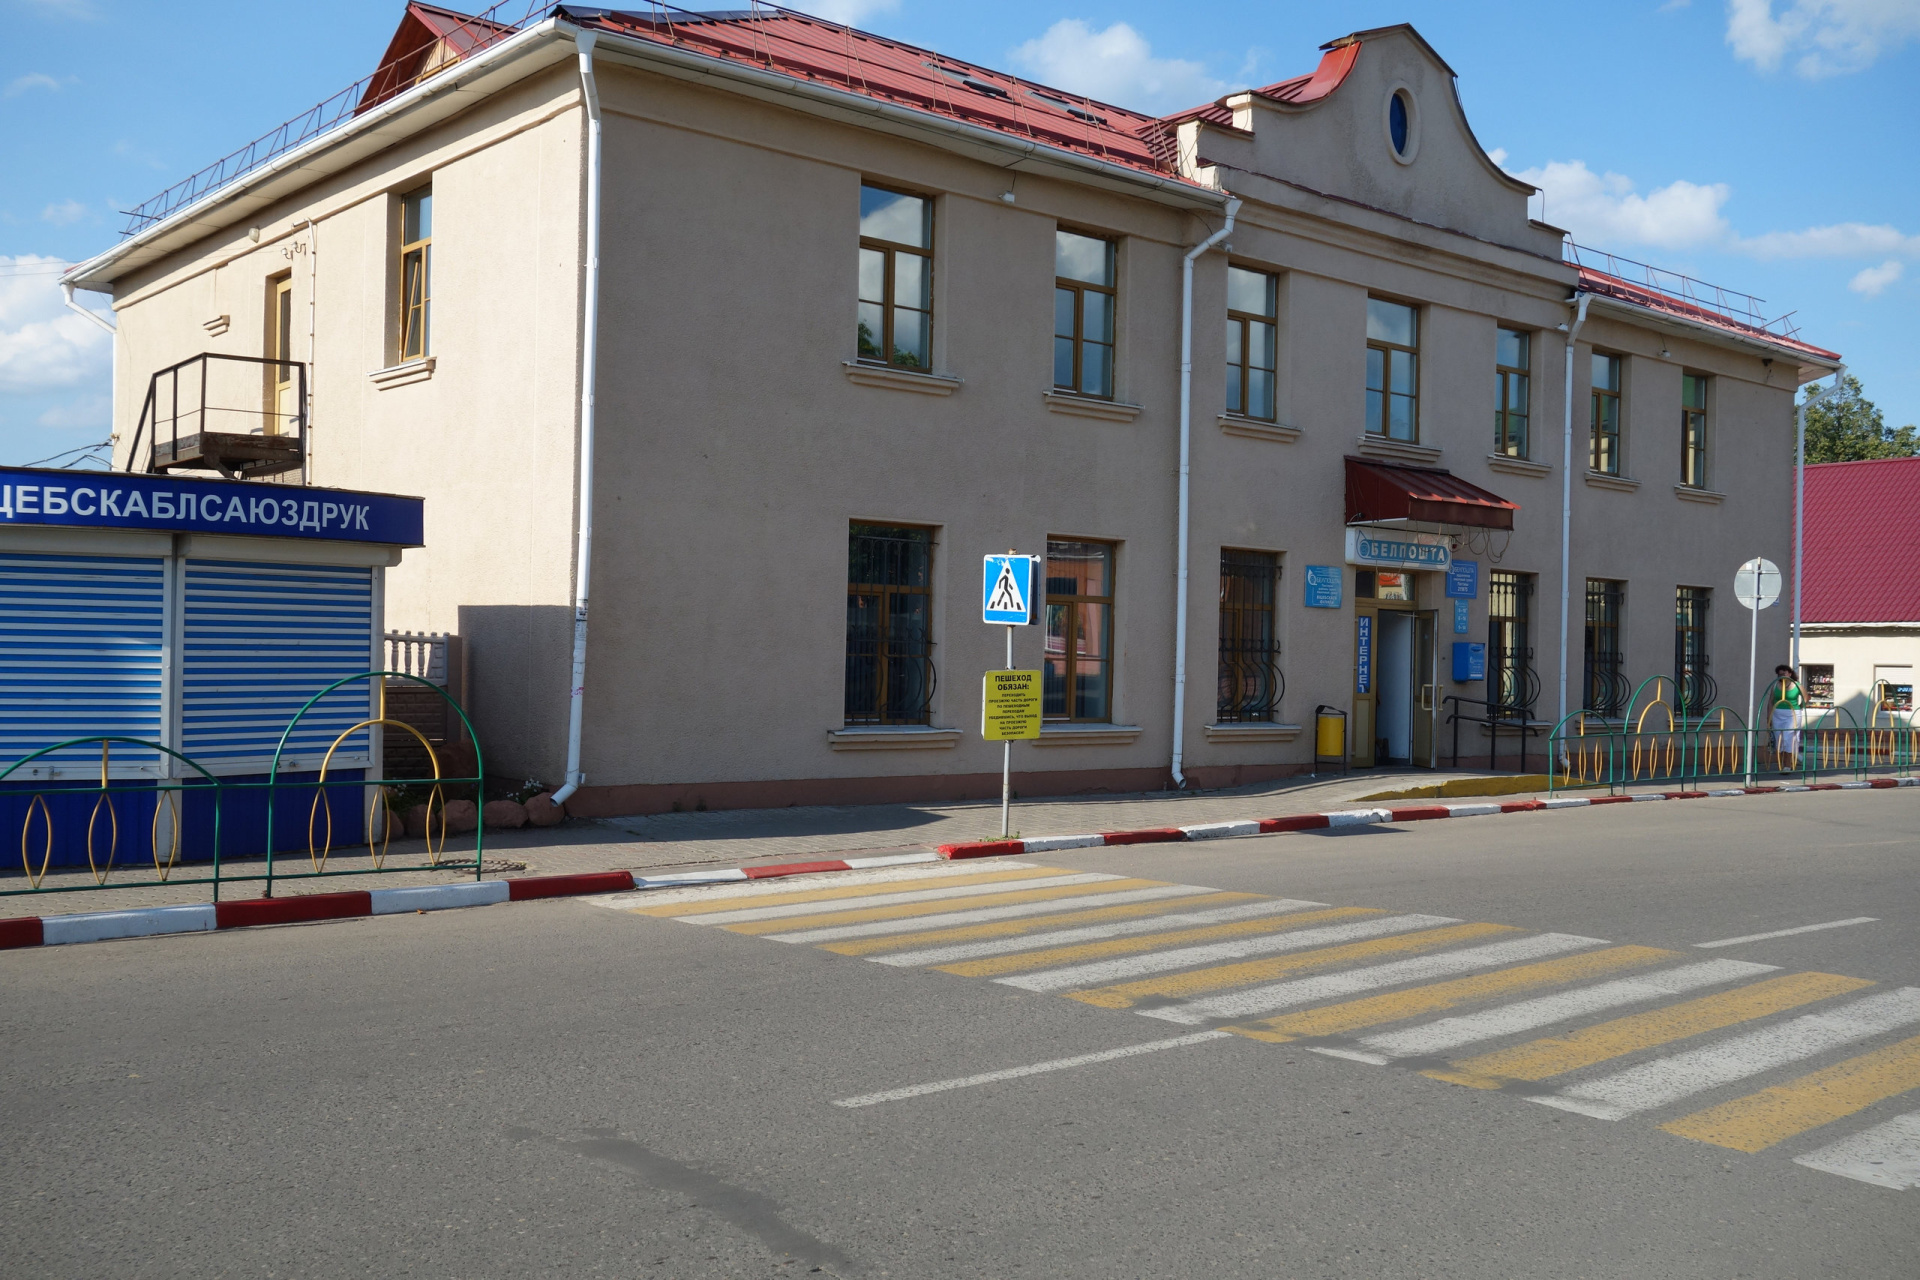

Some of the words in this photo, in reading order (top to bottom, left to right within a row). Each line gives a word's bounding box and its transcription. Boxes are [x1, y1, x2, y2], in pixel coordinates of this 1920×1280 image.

[1371, 542, 1446, 562] БЕЛПОШТА
[1359, 617, 1369, 693] ИНТЕРНЕТ
[995, 674, 1032, 682] ПЕШЕХОД
